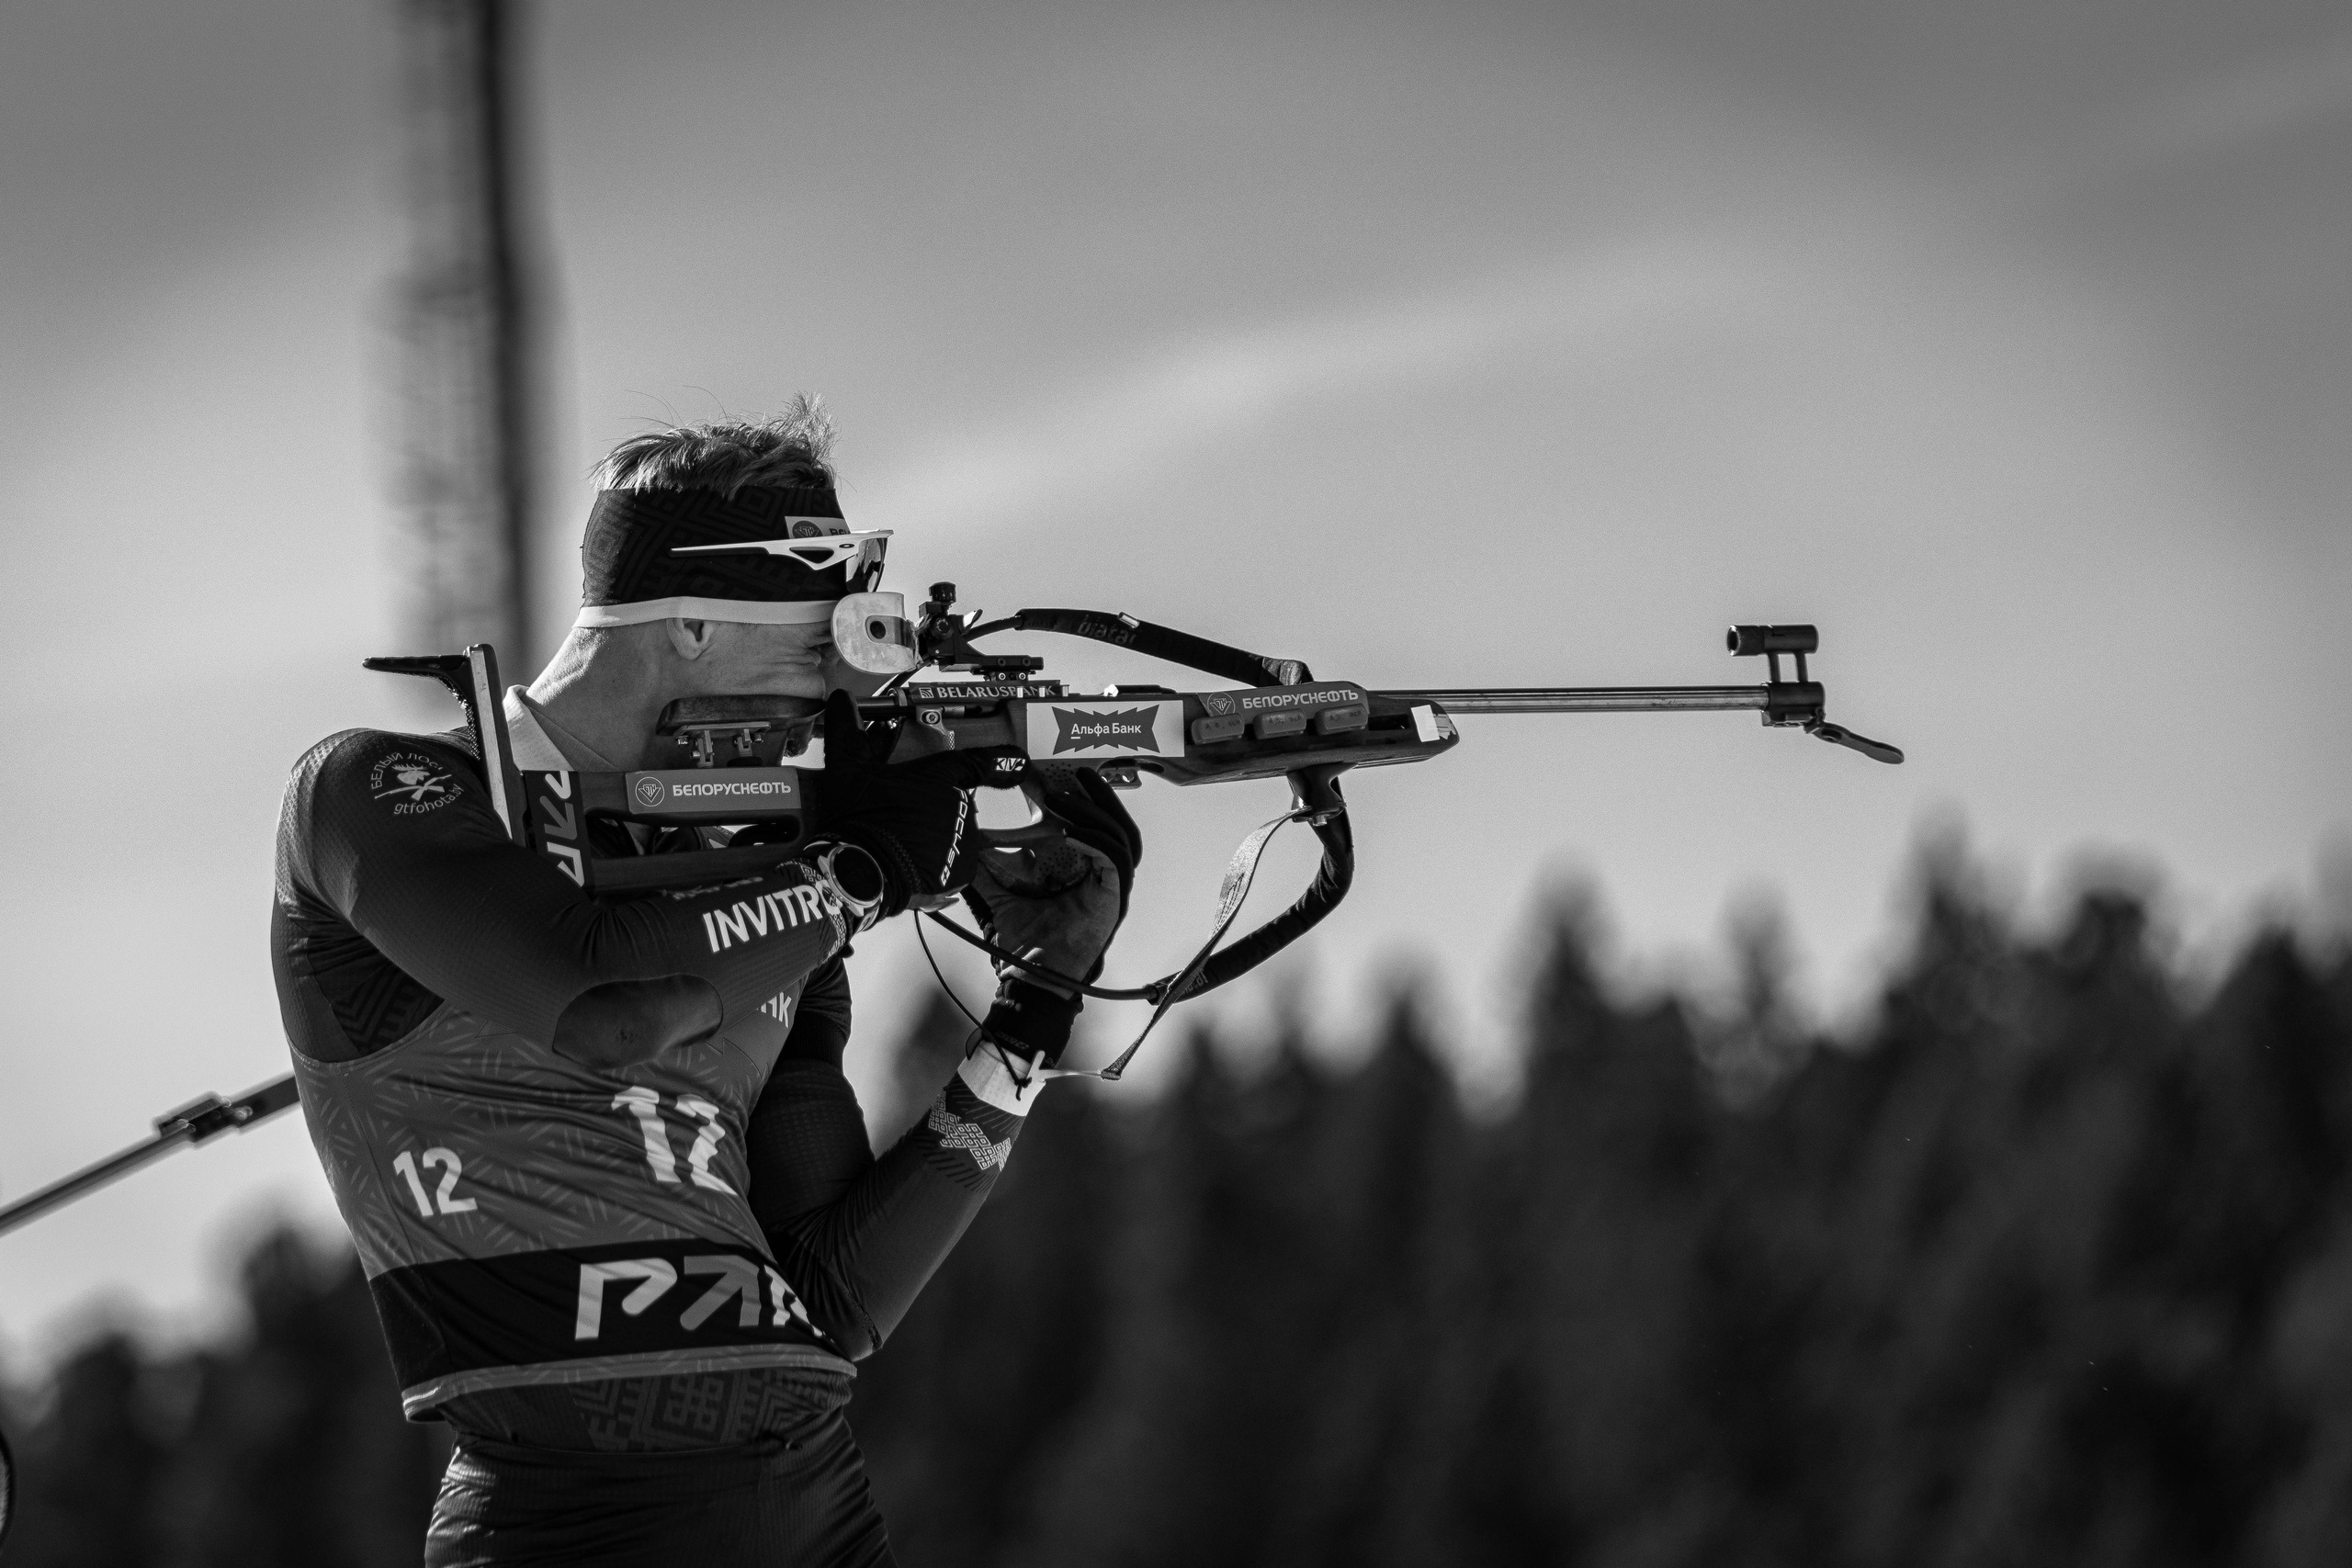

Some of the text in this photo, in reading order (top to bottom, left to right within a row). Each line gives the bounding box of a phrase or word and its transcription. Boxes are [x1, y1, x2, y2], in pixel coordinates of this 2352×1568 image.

[1242, 690, 1359, 709] БЕЛОРУСНЕФТЬ
[1070, 722, 1141, 737] Альфа Банк
[370, 751, 404, 789] БЕЛЫЙ
[393, 783, 465, 815] gtfohota.by
[672, 781, 792, 798] БЕЛОРУСНЕФТЬ
[392, 1145, 479, 1221] 12
